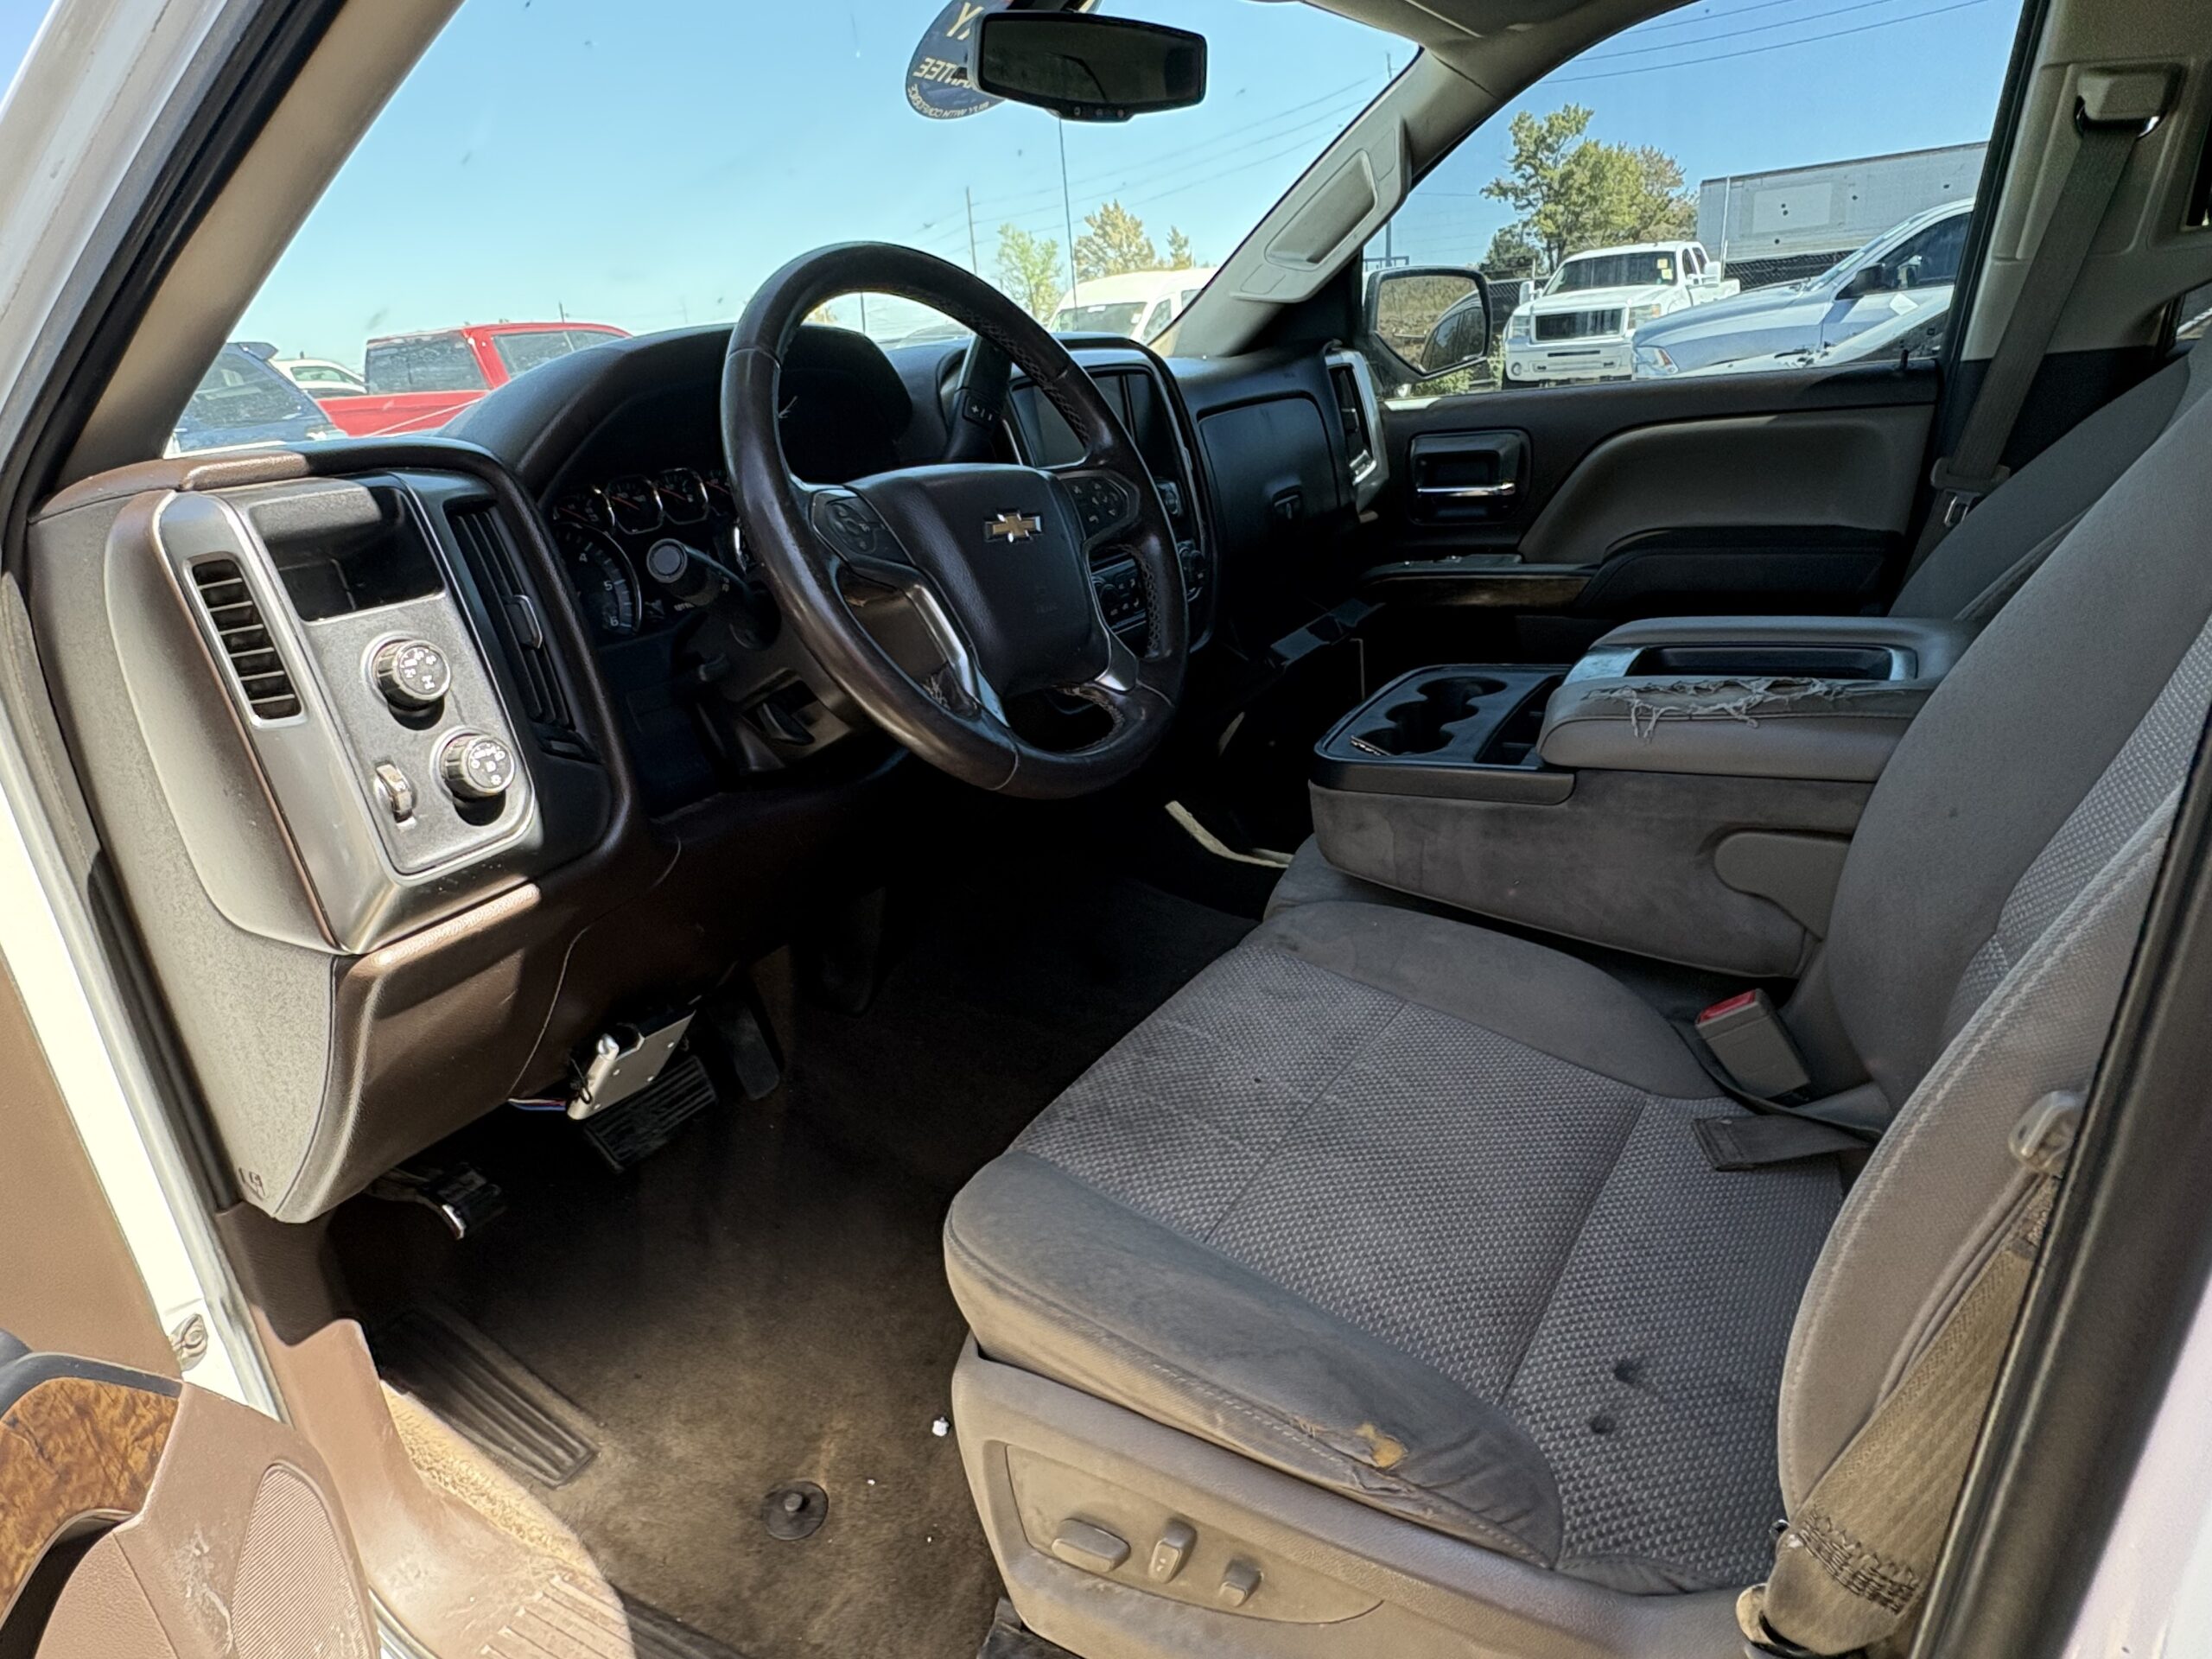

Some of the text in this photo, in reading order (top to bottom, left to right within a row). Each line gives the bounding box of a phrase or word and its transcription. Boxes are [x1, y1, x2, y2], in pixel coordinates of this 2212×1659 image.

[579, 553, 588, 562] 4
[603, 581, 613, 591] 5
[609, 617, 620, 626] 6
